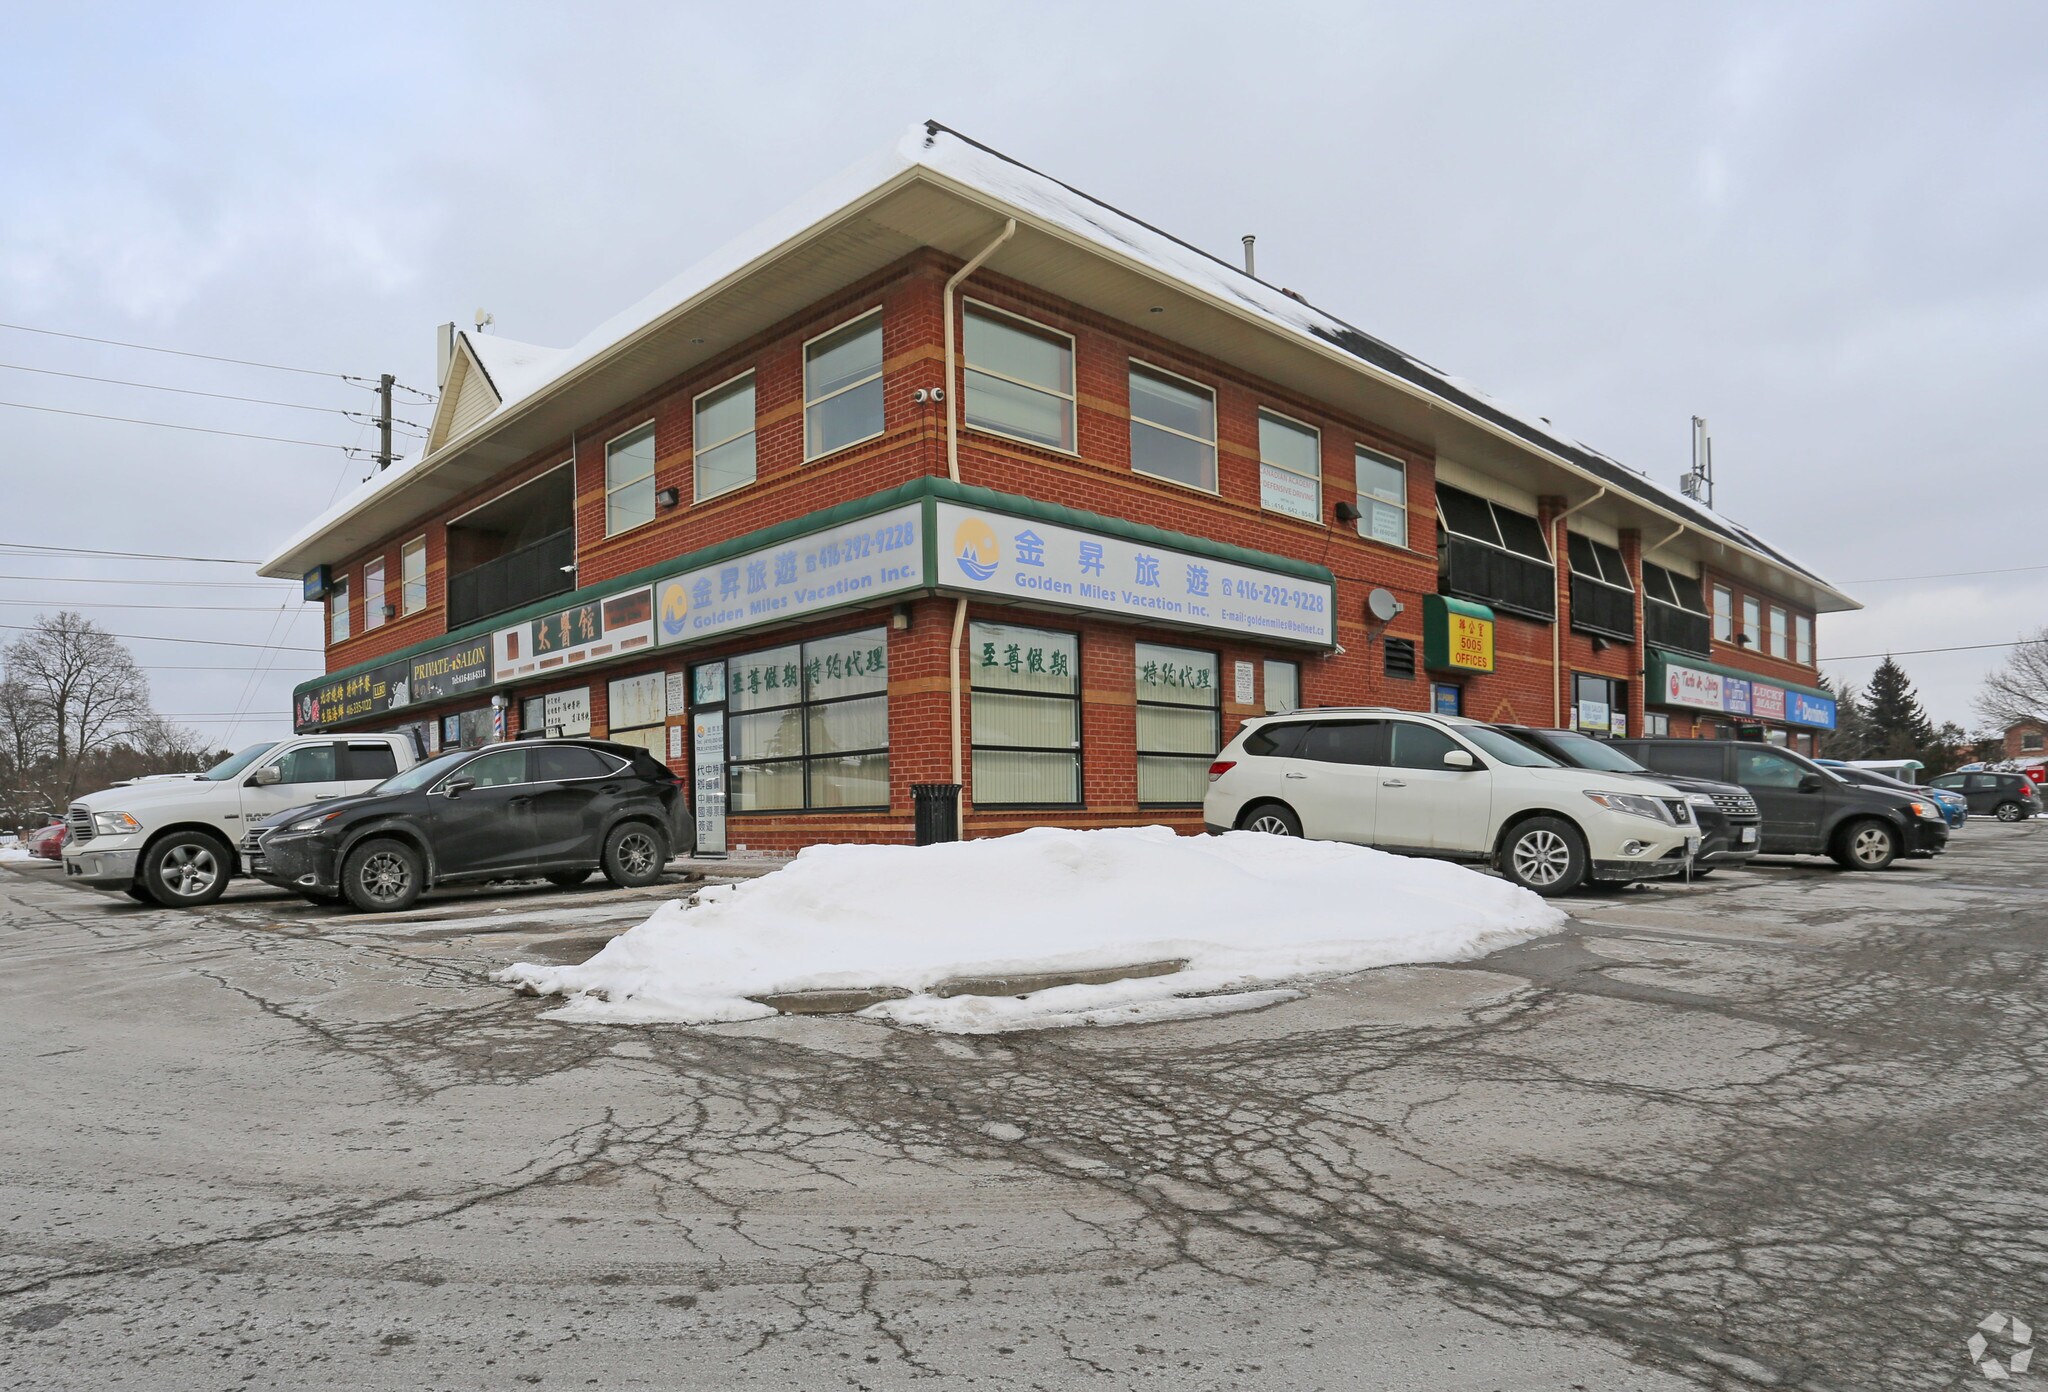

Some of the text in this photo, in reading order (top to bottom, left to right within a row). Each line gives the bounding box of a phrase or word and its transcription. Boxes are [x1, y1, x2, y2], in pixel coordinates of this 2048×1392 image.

[1263, 480, 1292, 495] DEFENSIVE
[1292, 489, 1315, 501] DRIVING
[692, 521, 914, 609] 金昇旅遊 416-292-9228
[1014, 529, 1324, 613] 金昇旅遊 416-292-9228
[693, 565, 915, 629] Golden Miles Vacation Inc.
[1015, 572, 1210, 617] Golden Miles Vacation Inc.
[981, 642, 1069, 677] 至尊假期
[1461, 638, 1482, 651] 5005
[1143, 660, 1212, 690] 特約代理
[1456, 652, 1487, 668] OFFICES
[1753, 686, 1784, 700] LUCKY
[1756, 699, 1781, 711] MART
